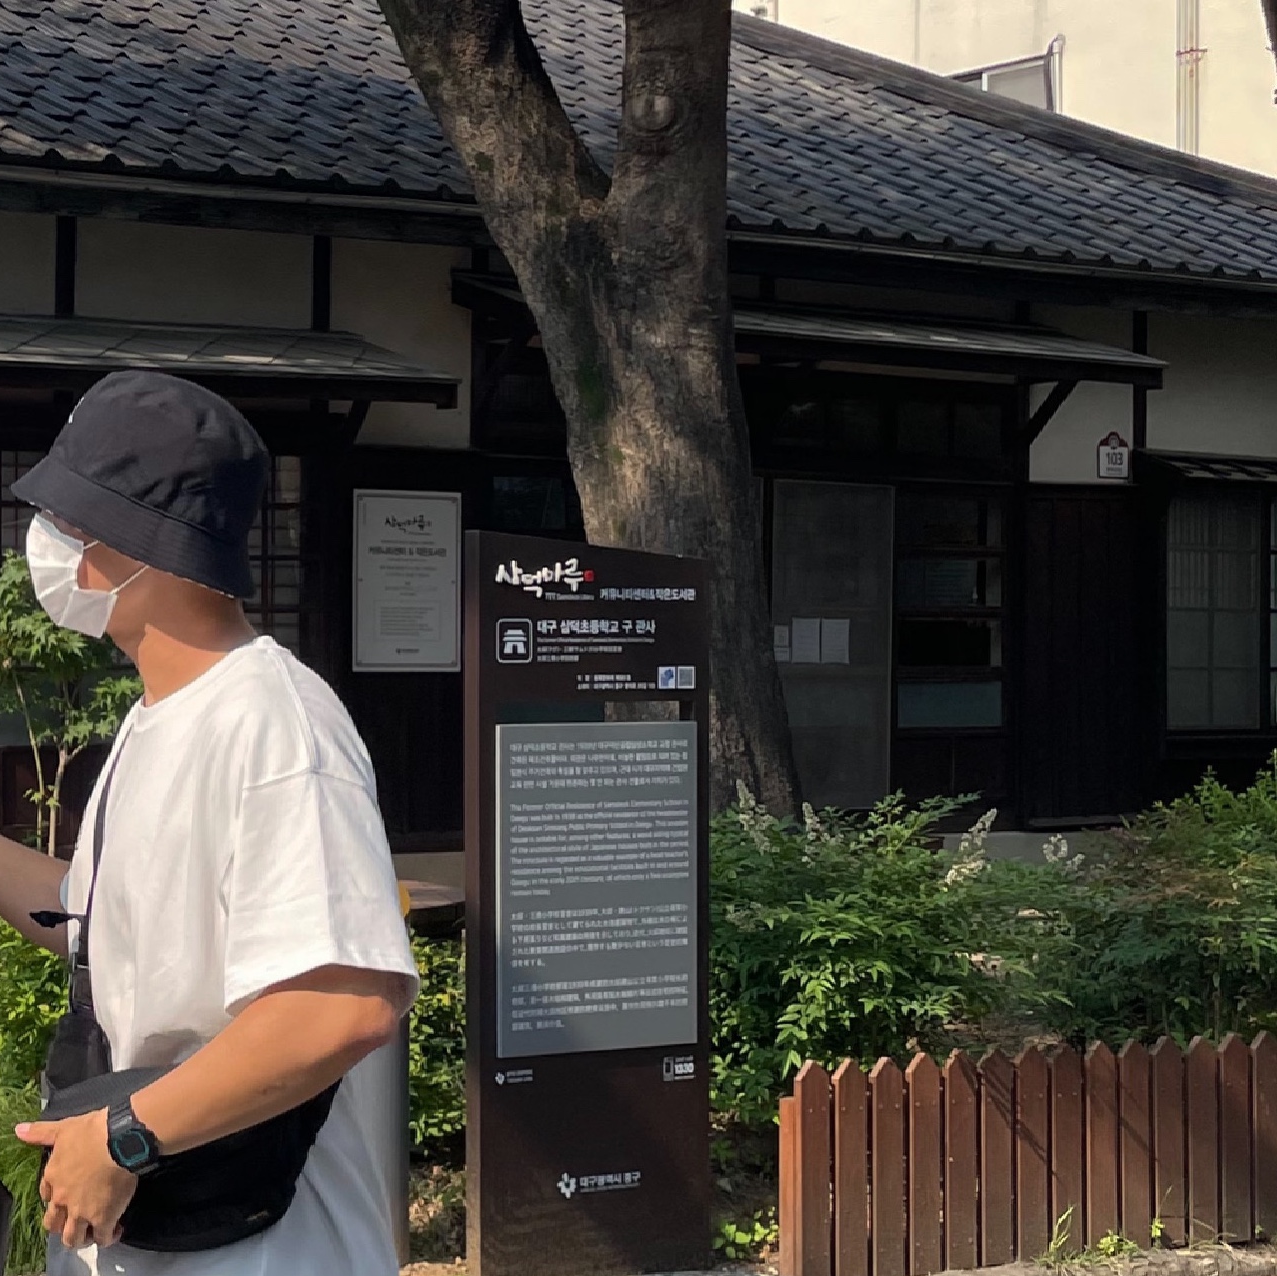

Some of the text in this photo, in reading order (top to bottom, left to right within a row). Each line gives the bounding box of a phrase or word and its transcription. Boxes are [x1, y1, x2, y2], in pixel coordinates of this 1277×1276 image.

[537, 619, 557, 635] 대구
[622, 619, 633, 635] 구
[635, 619, 656, 635] 관사
